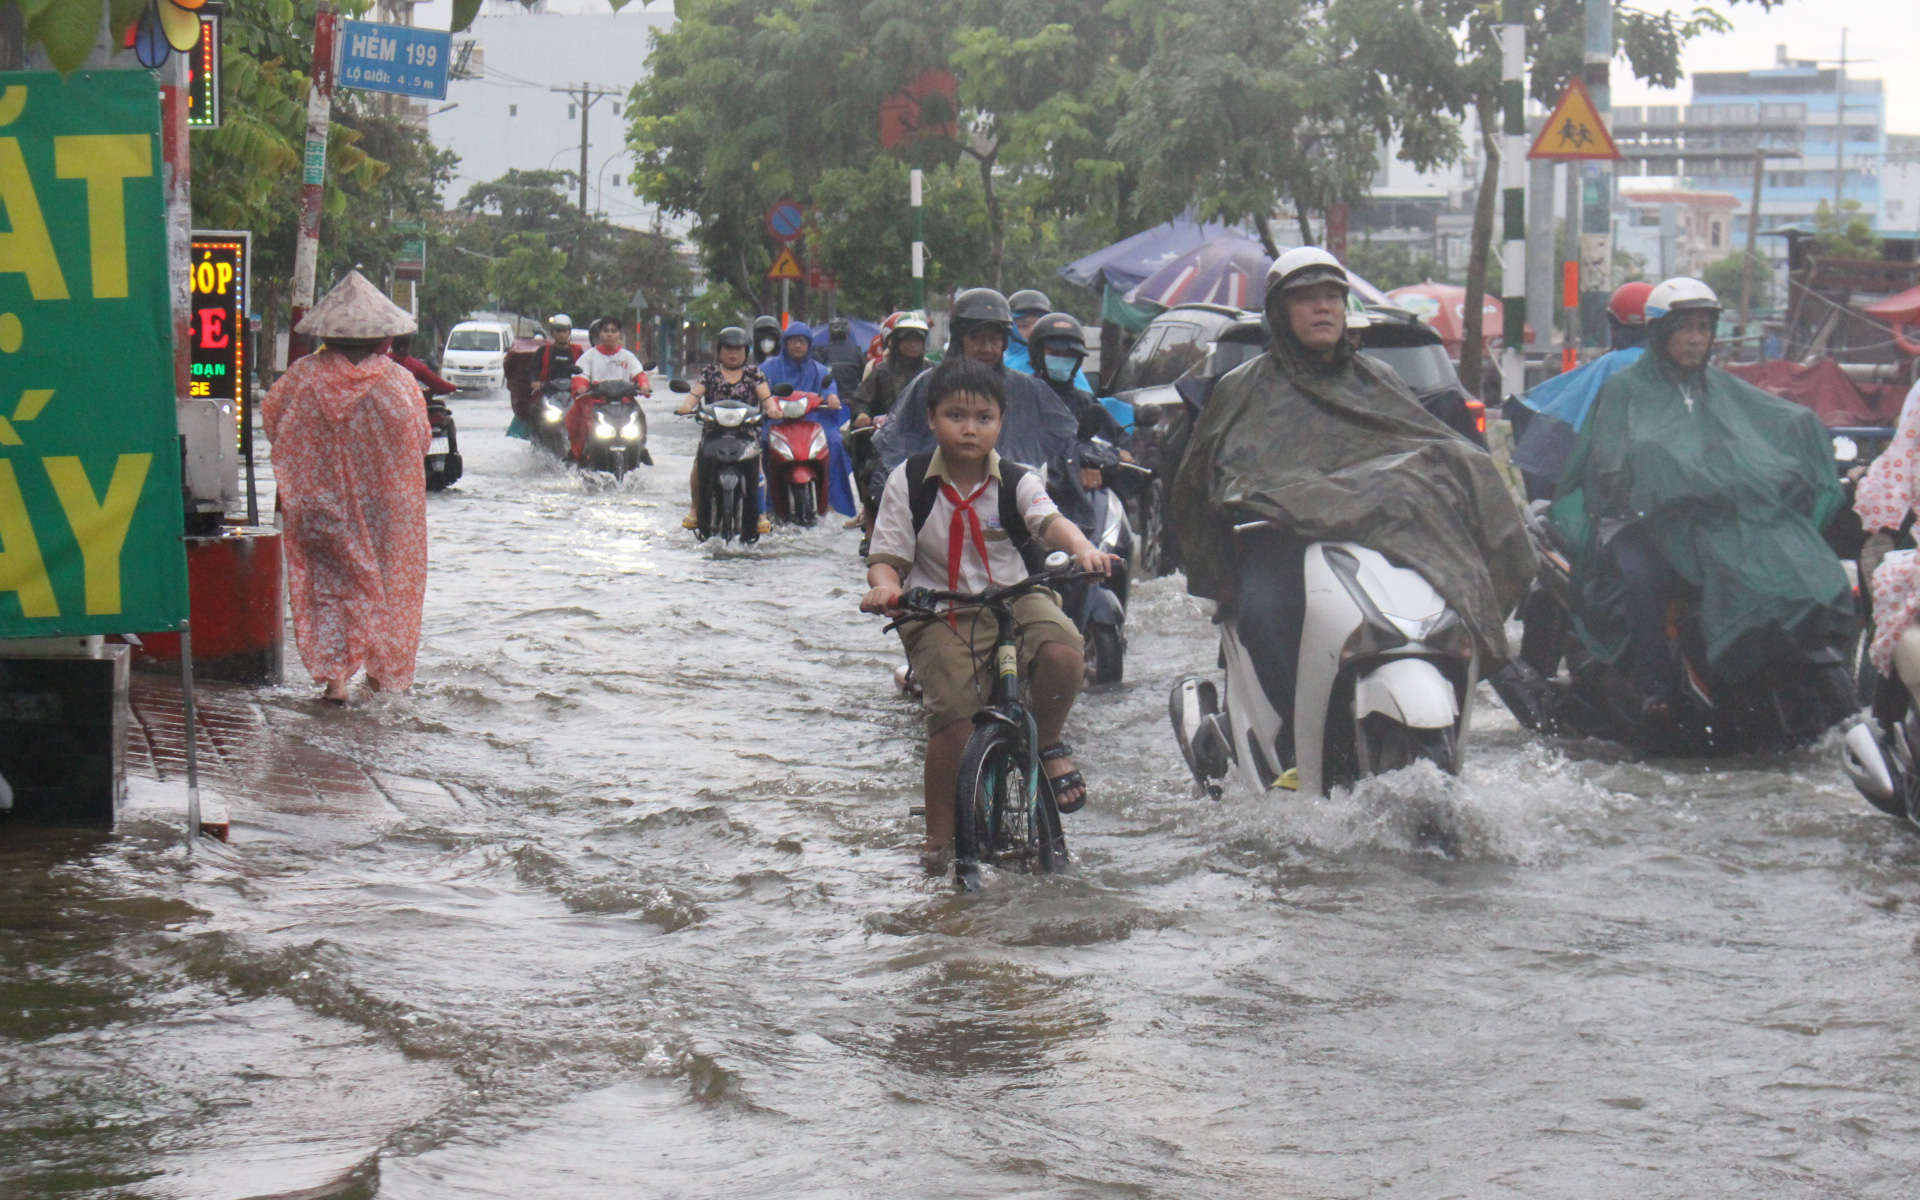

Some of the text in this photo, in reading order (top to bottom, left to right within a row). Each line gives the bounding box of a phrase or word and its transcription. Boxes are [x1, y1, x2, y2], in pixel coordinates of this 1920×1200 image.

[351, 28, 437, 67] HẺM 199
[346, 65, 361, 82] LỘ
